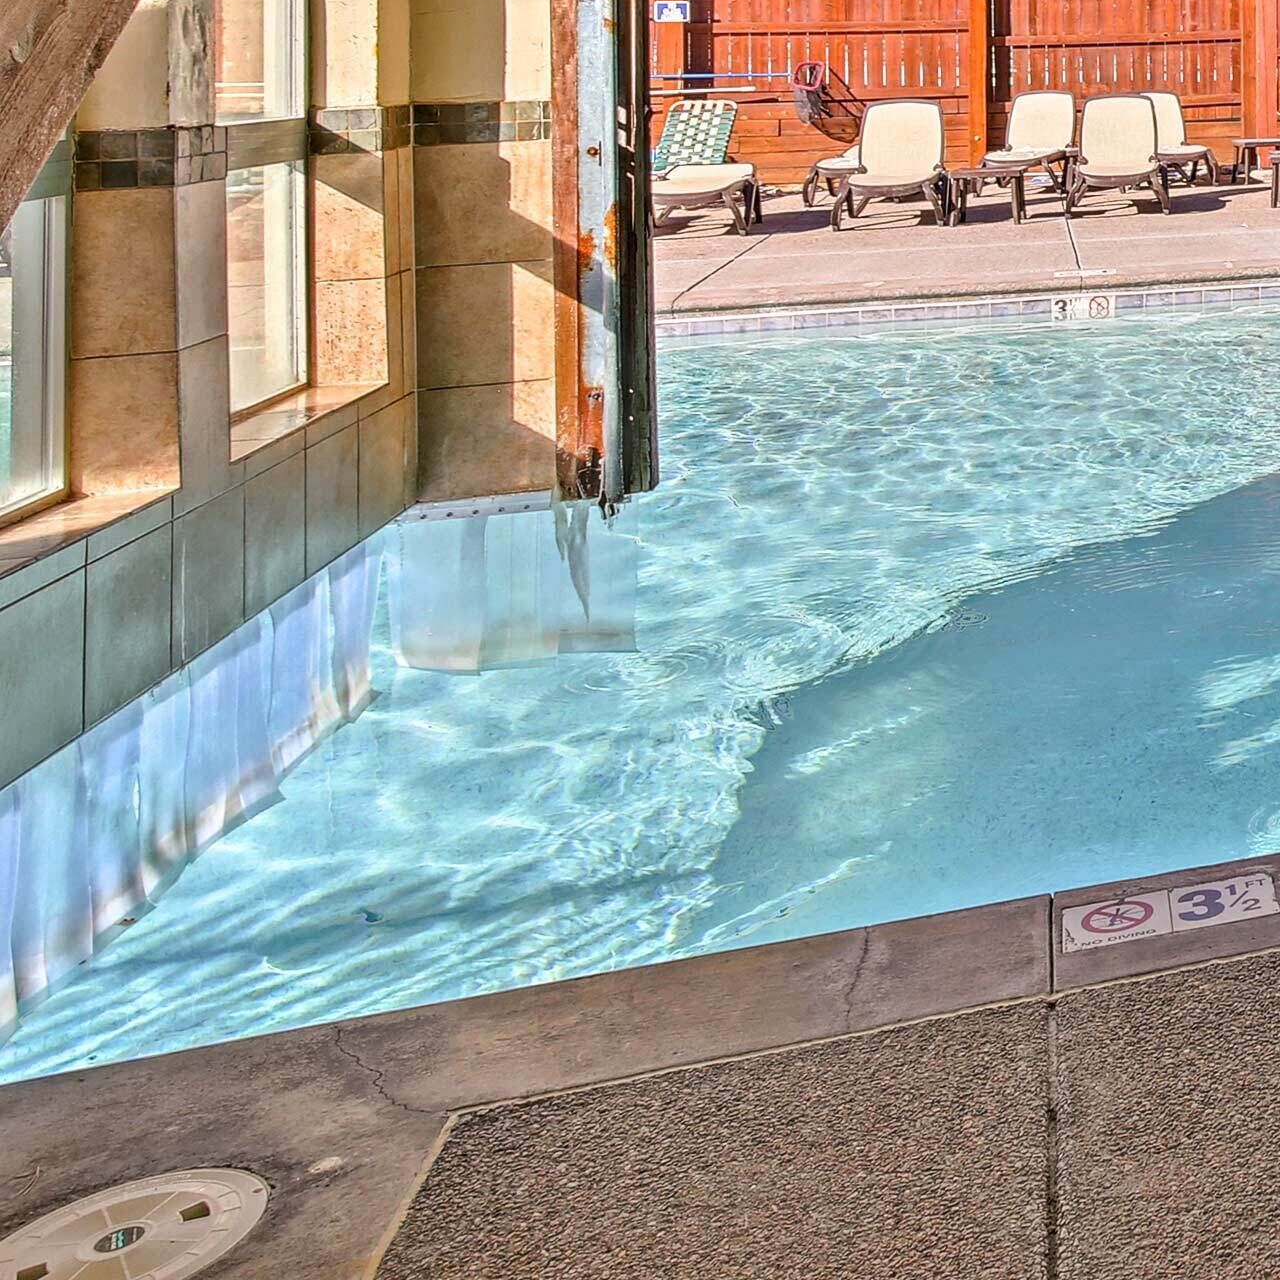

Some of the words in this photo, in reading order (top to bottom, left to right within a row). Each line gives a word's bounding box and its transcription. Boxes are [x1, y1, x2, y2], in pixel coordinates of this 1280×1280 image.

[1177, 889, 1226, 922] 3
[1245, 877, 1267, 889] FT
[1080, 938, 1103, 948] NO
[1107, 928, 1157, 943] DIVING
